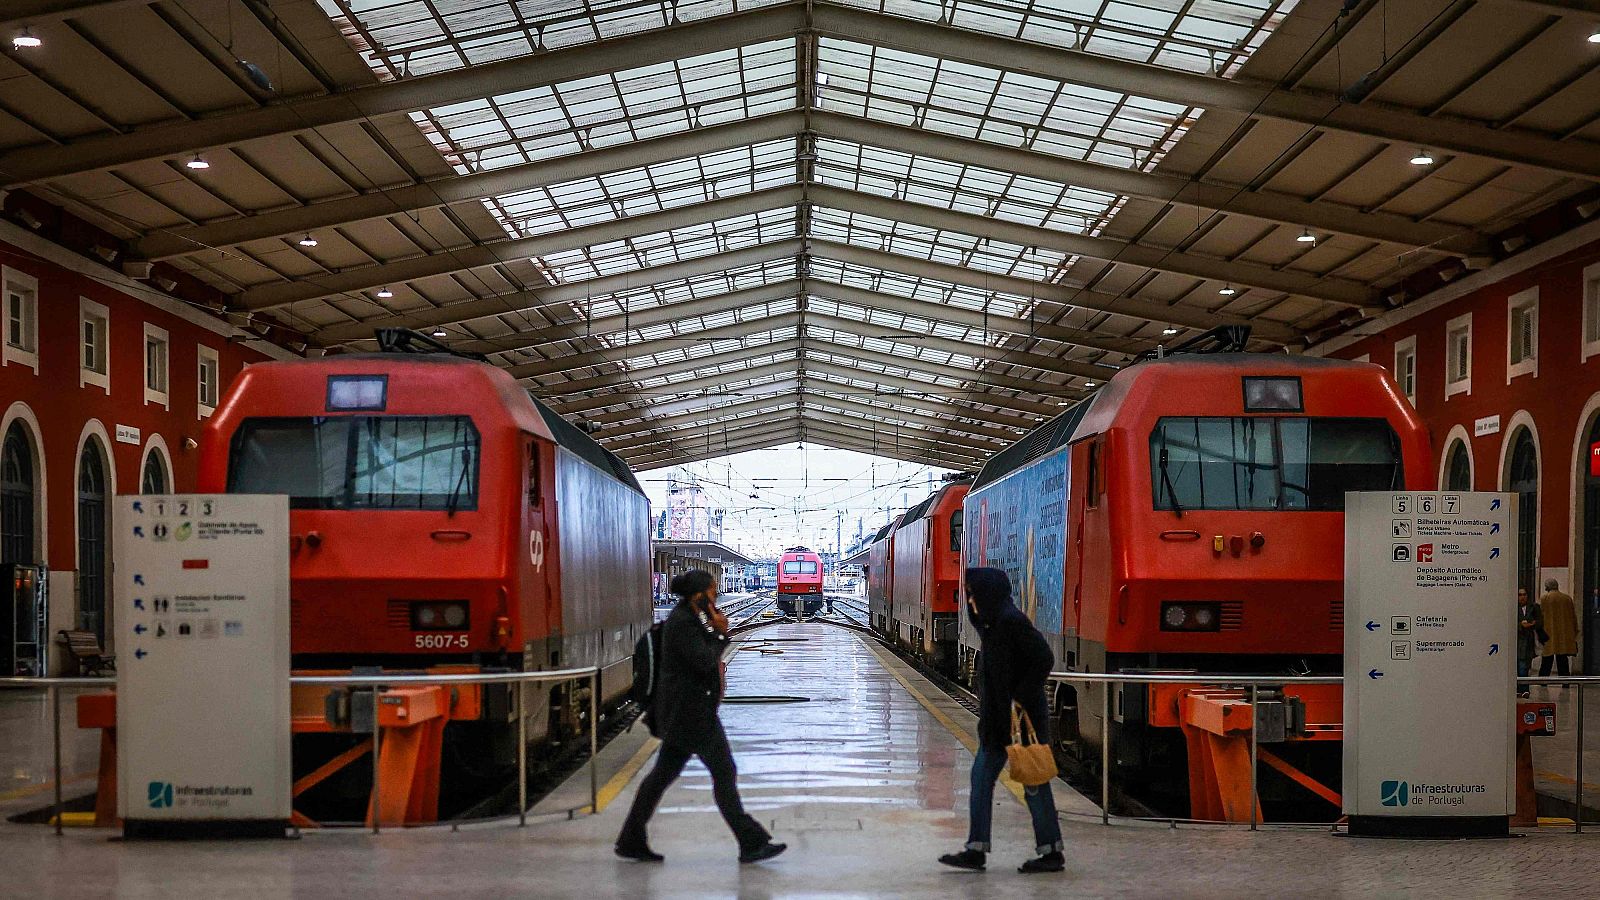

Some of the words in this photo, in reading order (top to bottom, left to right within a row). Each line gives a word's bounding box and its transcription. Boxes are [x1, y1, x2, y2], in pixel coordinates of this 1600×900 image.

[158, 504, 164, 514] 1
[180, 504, 188, 516] 2
[203, 504, 212, 516] 3
[1398, 502, 1406, 512] 5
[1424, 501, 1430, 512] 6
[1448, 502, 1454, 512] 7
[415, 634, 469, 648] 5607-5
[1411, 784, 1486, 794] Infraestruturas
[1412, 796, 1423, 804] de
[1428, 795, 1465, 806] Portugal
